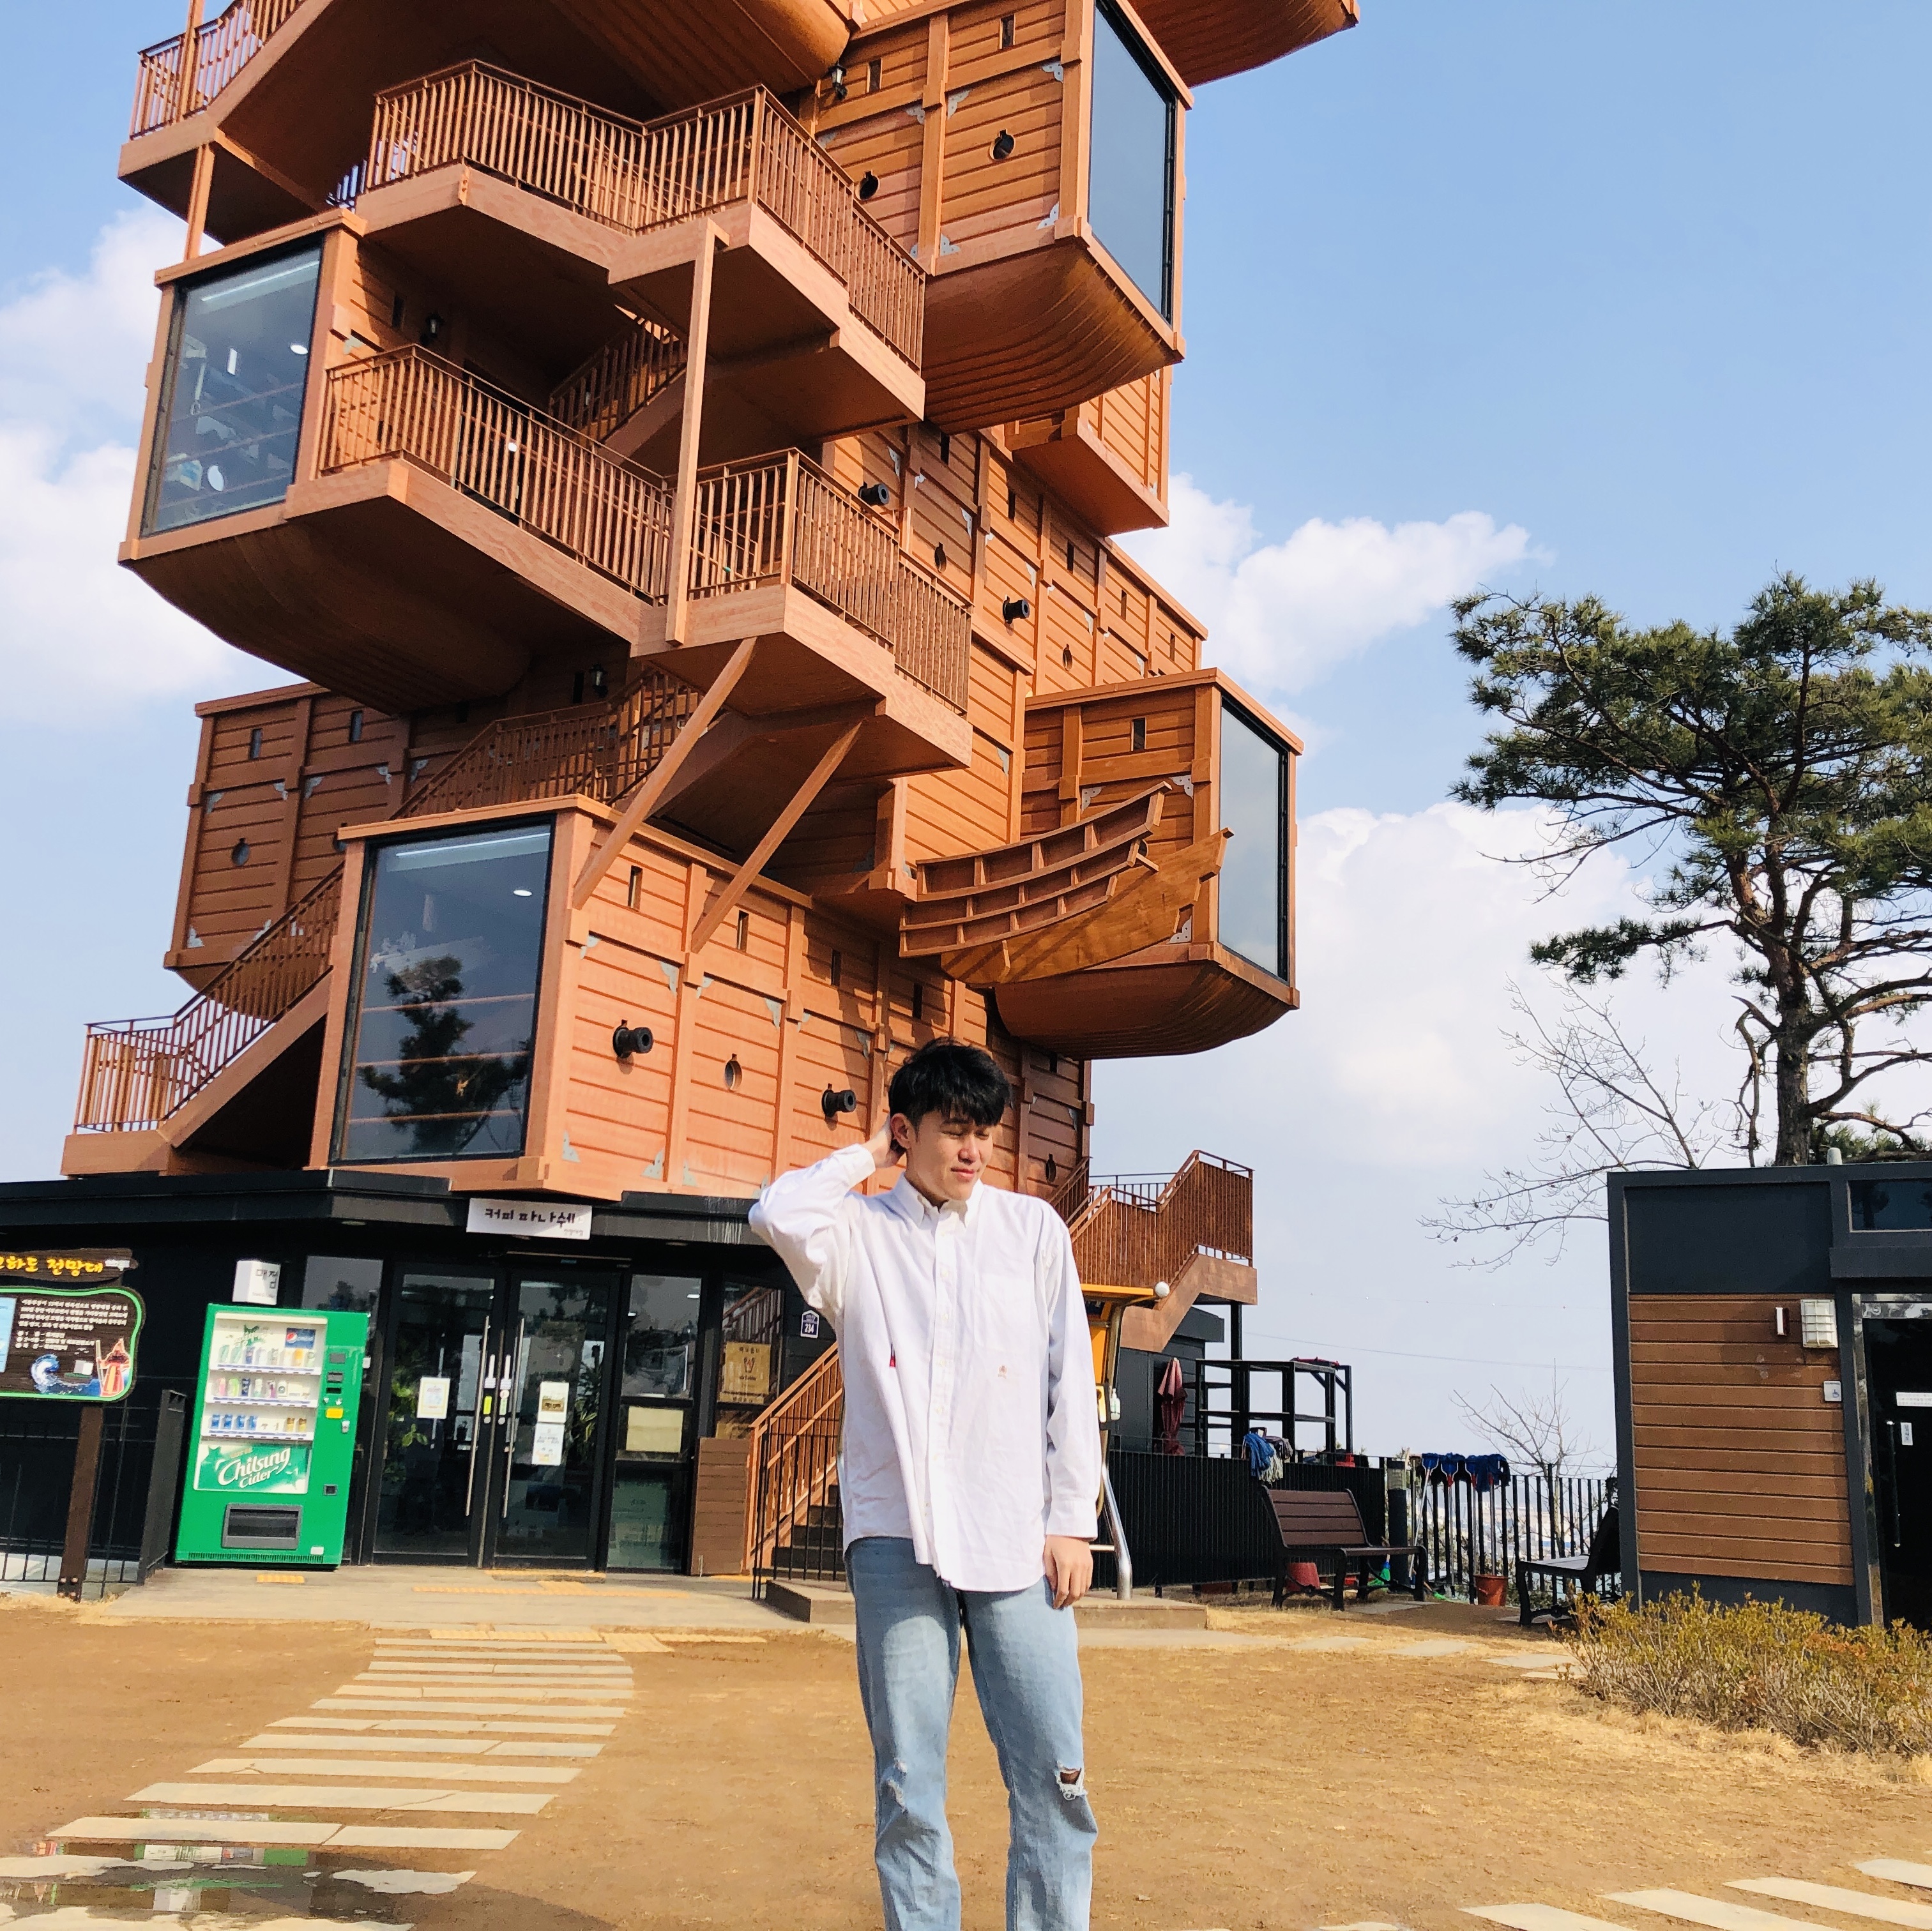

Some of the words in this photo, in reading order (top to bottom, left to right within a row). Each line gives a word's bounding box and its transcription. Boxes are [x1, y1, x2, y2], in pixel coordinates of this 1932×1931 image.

[485, 1208, 514, 1220] 커피
[0, 1255, 38, 1273] 하도
[46, 1258, 103, 1276] 전망대
[804, 1323, 814, 1333] 234
[218, 1447, 291, 1486] Chilsung
[238, 1466, 279, 1488] Cider
